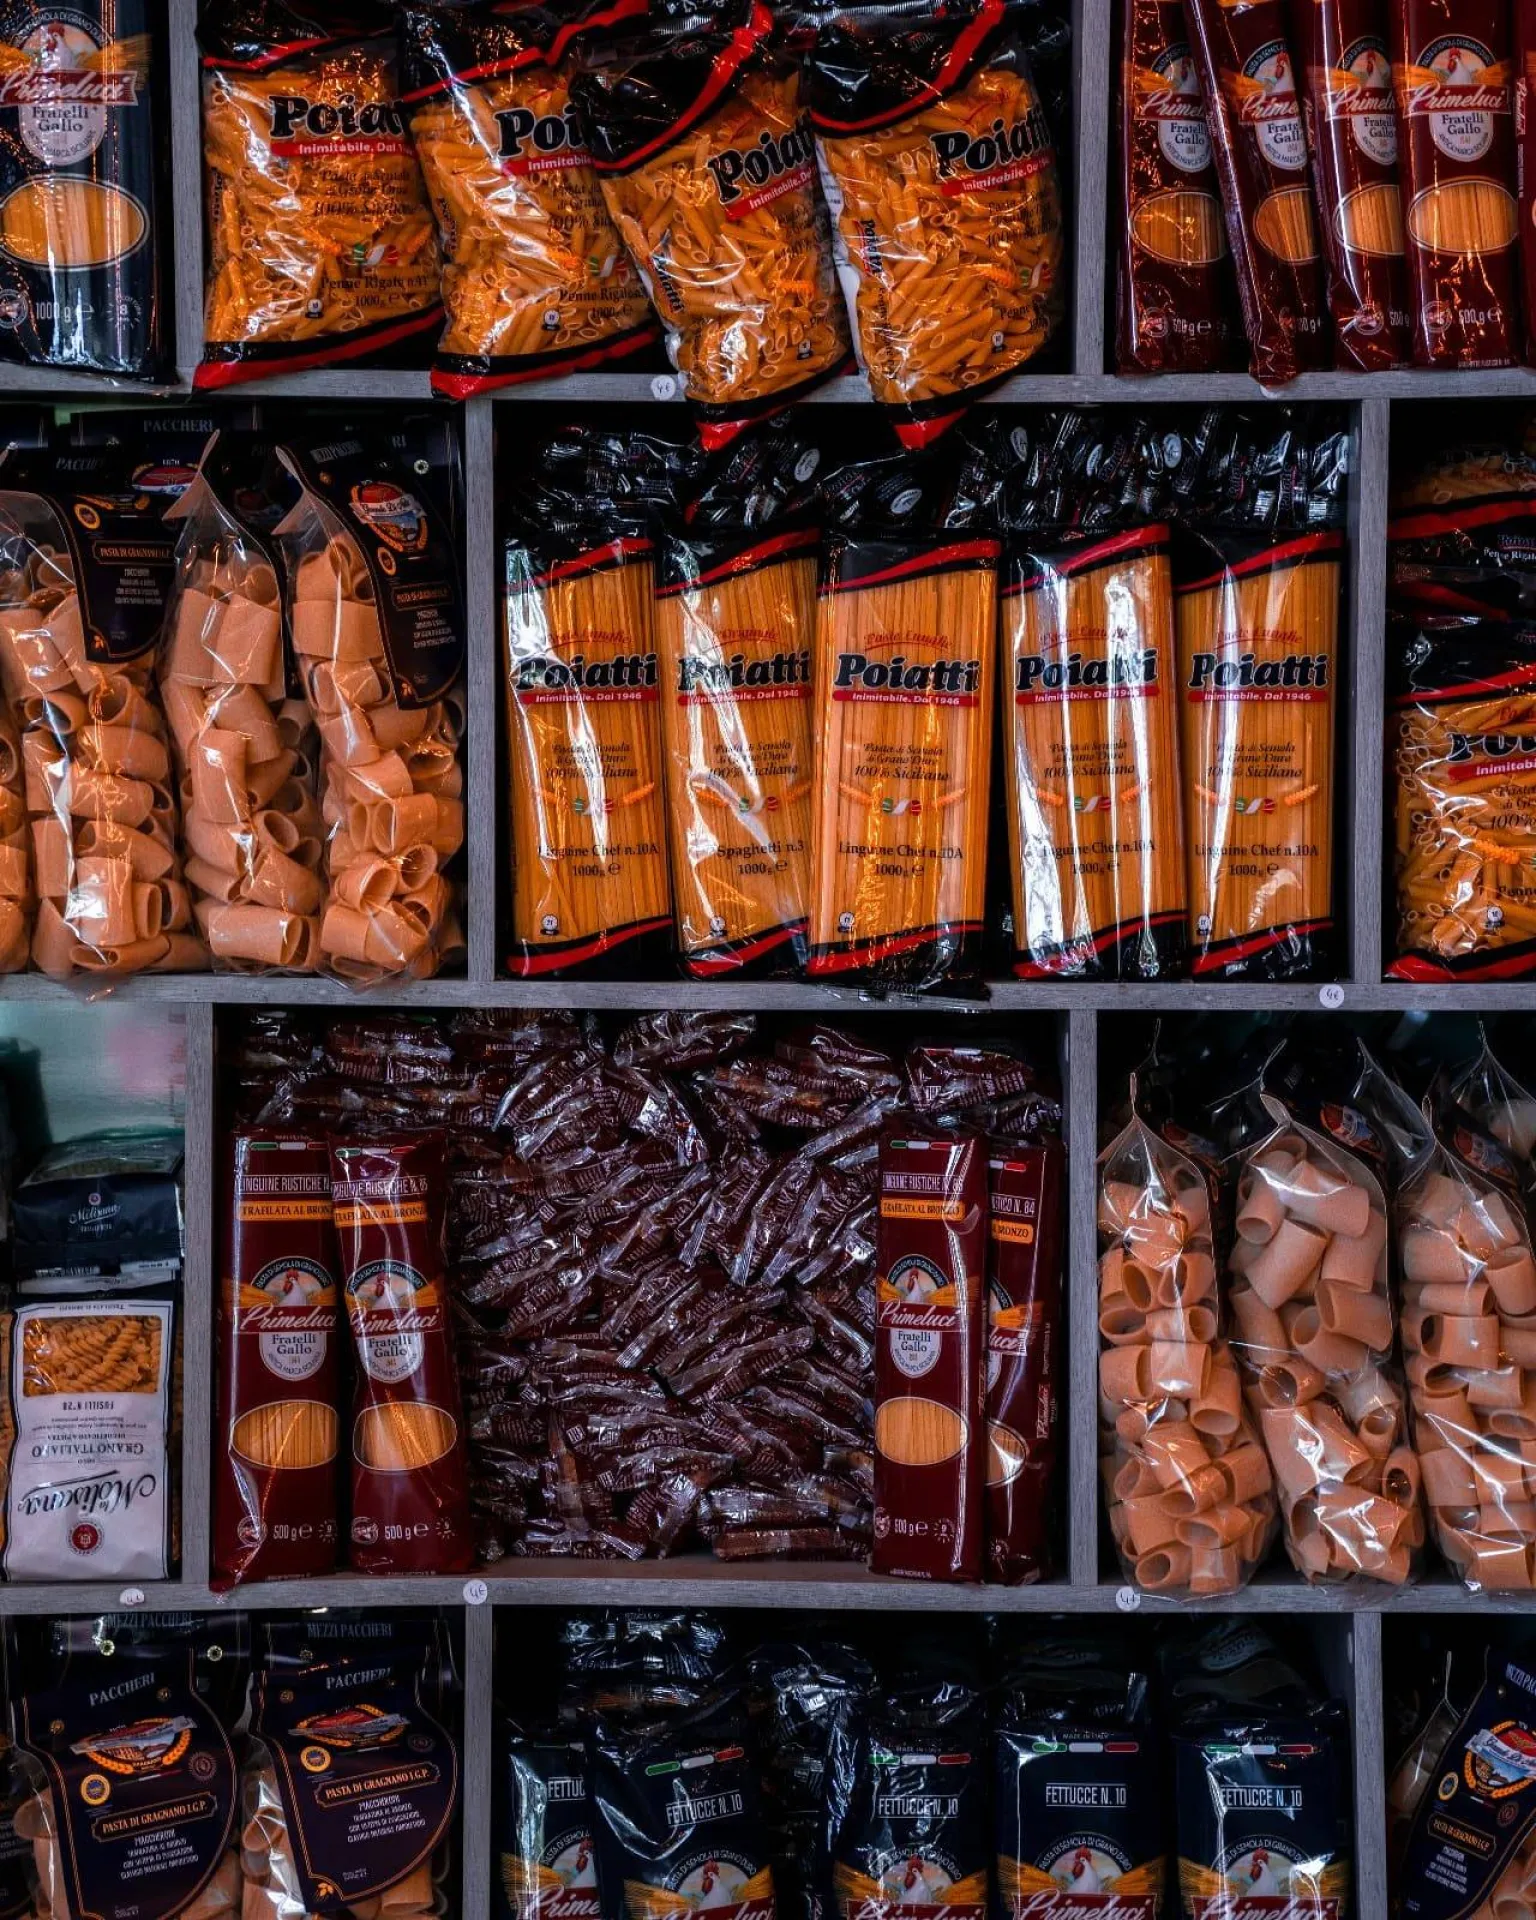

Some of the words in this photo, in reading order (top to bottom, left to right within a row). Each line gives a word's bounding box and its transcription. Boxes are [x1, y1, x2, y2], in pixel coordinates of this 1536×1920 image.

[1408, 80, 1506, 111] Primeluci
[38, 118, 83, 132] Gallo
[1442, 114, 1484, 125] Fratelli
[1369, 128, 1394, 138] Gallo
[1447, 125, 1481, 136] Gallo
[1174, 134, 1205, 145] Gallo
[299, 142, 374, 155] Inimitabile.
[377, 142, 396, 153] Dal
[1458, 308, 1476, 324] 500
[143, 419, 214, 433] PACCHERI
[833, 653, 981, 694] Poiatti
[1188, 652, 1330, 689] Poiatti
[597, 691, 615, 702] Dal
[616, 690, 643, 701] 1946
[756, 690, 776, 701] Dal
[778, 689, 800, 699] 1946
[852, 692, 912, 704] Inimitabile.
[914, 695, 933, 705] Dal
[934, 696, 960, 706] 1946
[1035, 690, 1092, 703] Inimitabile.
[1204, 691, 1262, 702] Inimitabile.
[1264, 691, 1283, 701] Dal
[1285, 691, 1312, 701] 1946
[1258, 742, 1296, 754] Semola
[1264, 751, 1293, 763] Duro
[1246, 765, 1303, 778] Siciliano
[539, 845, 590, 859] inguine
[592, 843, 622, 856] Chef
[717, 841, 782, 859] Spaghetti
[784, 841, 805, 852] n.3
[896, 843, 927, 857] Chef
[1091, 841, 1121, 855] Chef
[1250, 844, 1282, 857] Chef
[1283, 844, 1320, 858] n.10A
[281, 1177, 322, 1192] RUSTICHE
[241, 1204, 293, 1215] TRAFILATA
[293, 1204, 305, 1214] AL
[1024, 1199, 1036, 1214] 84
[880, 1298, 961, 1328] Primeluci
[272, 1332, 316, 1344] Fratelli
[369, 1334, 412, 1349] Fratelli
[898, 1330, 932, 1343] Fratelli
[276, 1344, 312, 1355] Gallo
[374, 1346, 408, 1358] Gallo
[900, 1341, 928, 1353] Gallo
[84, 1400, 115, 1411] FUSILLI
[31, 1442, 94, 1458] ITALIAO
[97, 1441, 144, 1455] GRANO
[17, 1473, 157, 1516] Molisana
[273, 1524, 289, 1540] 500
[290, 1526, 297, 1541] g
[384, 1524, 404, 1541] 500
[405, 1526, 412, 1541] g
[140, 1611, 193, 1628] PACCHERI
[307, 1622, 339, 1638] MEZZI
[340, 1622, 393, 1638] PACCHERI
[325, 1667, 392, 1690] PACCHERI
[88, 1672, 156, 1707] PACCHERI
[325, 1785, 351, 1800] PASTA
[352, 1782, 363, 1794] DI
[364, 1772, 409, 1790] GRAGNANO
[1046, 1786, 1099, 1805] FETTUCCE
[1100, 1786, 1113, 1805] N.
[1116, 1786, 1128, 1805] 10
[1220, 1787, 1273, 1807] FETTUCCE
[1275, 1788, 1288, 1807] N.
[1291, 1788, 1303, 1807] 10
[665, 1798, 717, 1825] FETTUCCE
[731, 1793, 744, 1812] 10
[877, 1798, 930, 1816] FETTUCCE
[947, 1797, 960, 1815] 10
[102, 1819, 129, 1834] PASTA
[129, 1816, 141, 1827] DI
[141, 1805, 187, 1825] GRAGNANO
[1059, 1836, 1087, 1851] SEMOLA
[1087, 1836, 1096, 1845] DI
[1095, 1837, 1119, 1856] GRANO
[1235, 1838, 1263, 1854] SEMOLA
[1264, 1838, 1272, 1847] DI
[1271, 1840, 1297, 1858] GRANO
[1018, 1888, 1152, 1920] Primeluci
